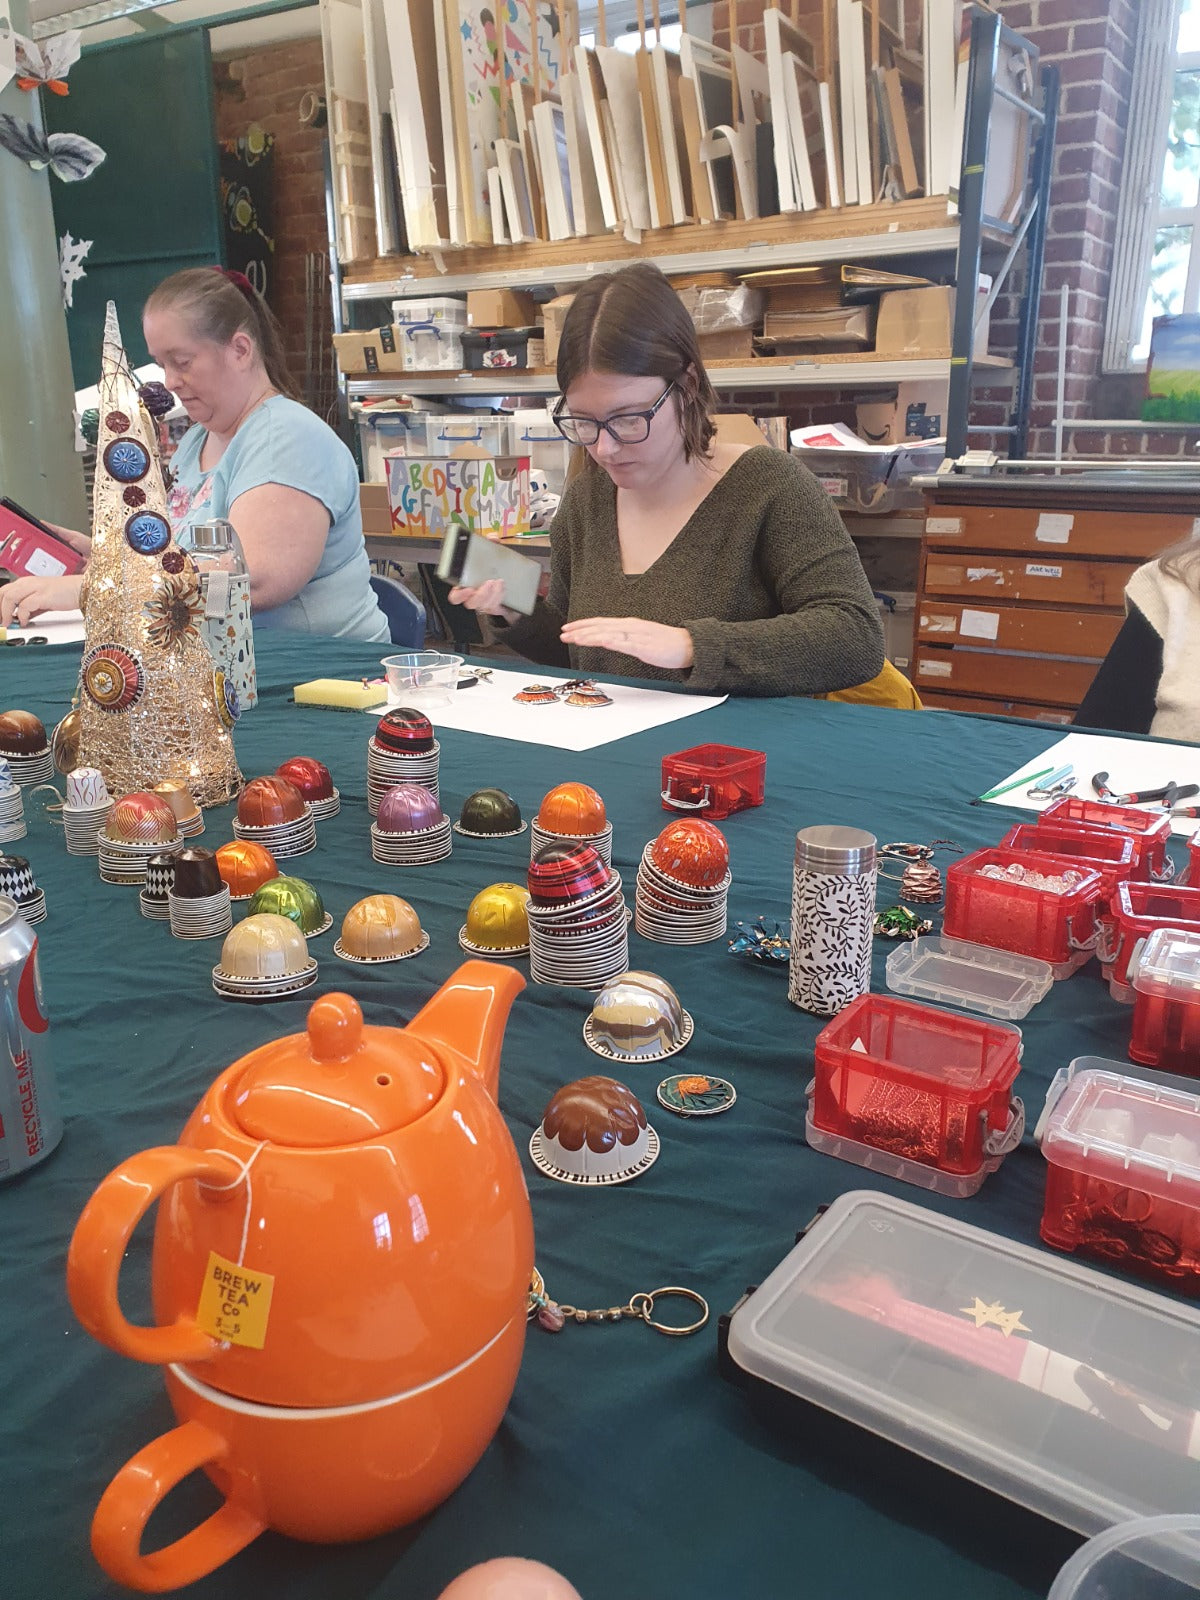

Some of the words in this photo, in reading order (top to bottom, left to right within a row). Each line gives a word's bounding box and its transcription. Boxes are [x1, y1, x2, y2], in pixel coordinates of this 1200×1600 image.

[14, 1050, 28, 1080] ME
[19, 1081, 39, 1156] RECYCLE
[213, 1266, 261, 1294] BREW
[218, 1284, 249, 1307] TEA
